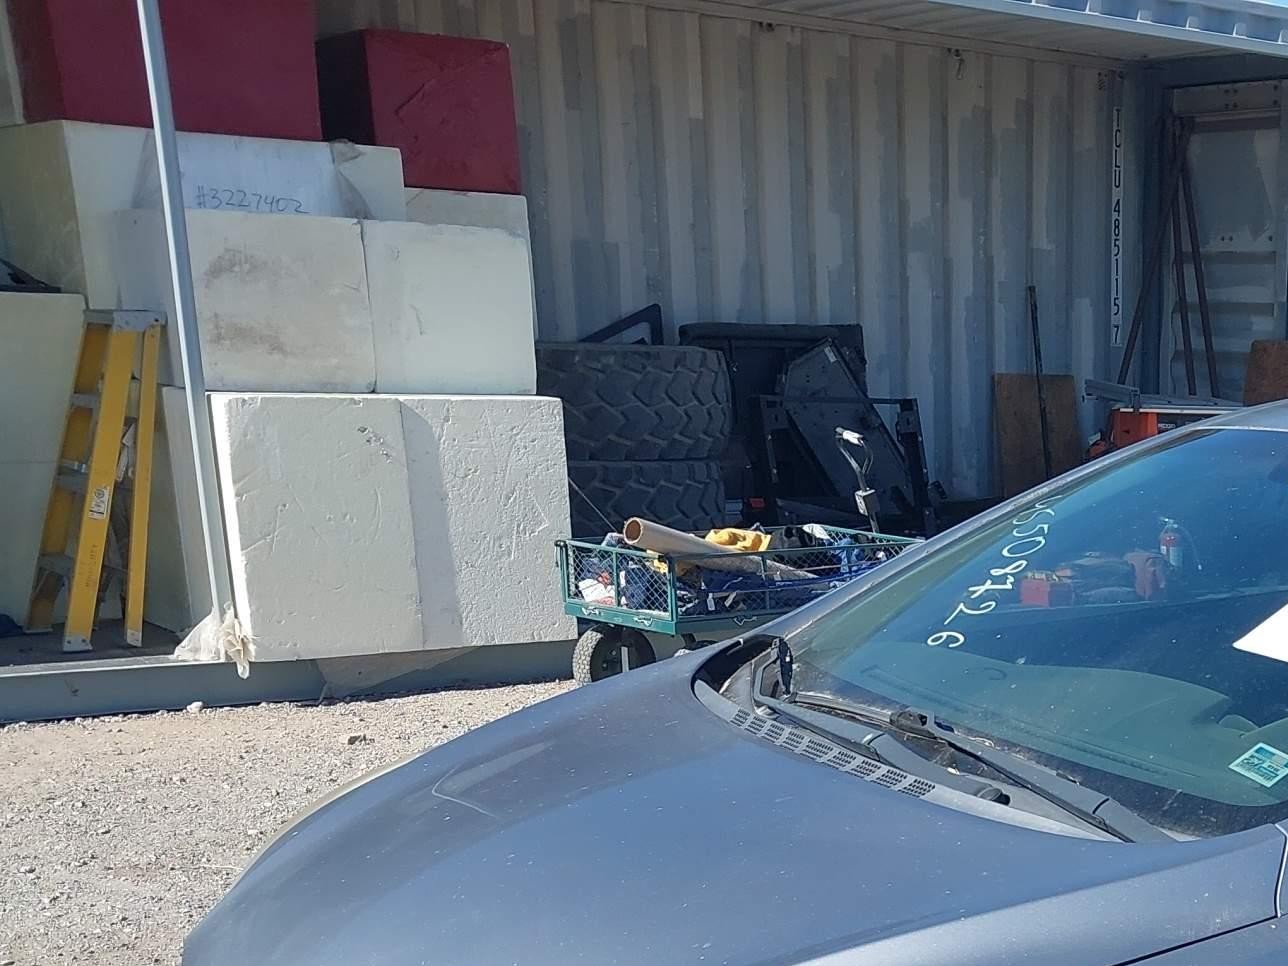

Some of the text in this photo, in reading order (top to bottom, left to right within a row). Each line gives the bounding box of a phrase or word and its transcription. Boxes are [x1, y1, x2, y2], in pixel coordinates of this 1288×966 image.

[196, 185, 311, 214] #3227402
[1113, 198, 1121, 316] 485115
[1112, 325, 1120, 344] 7
